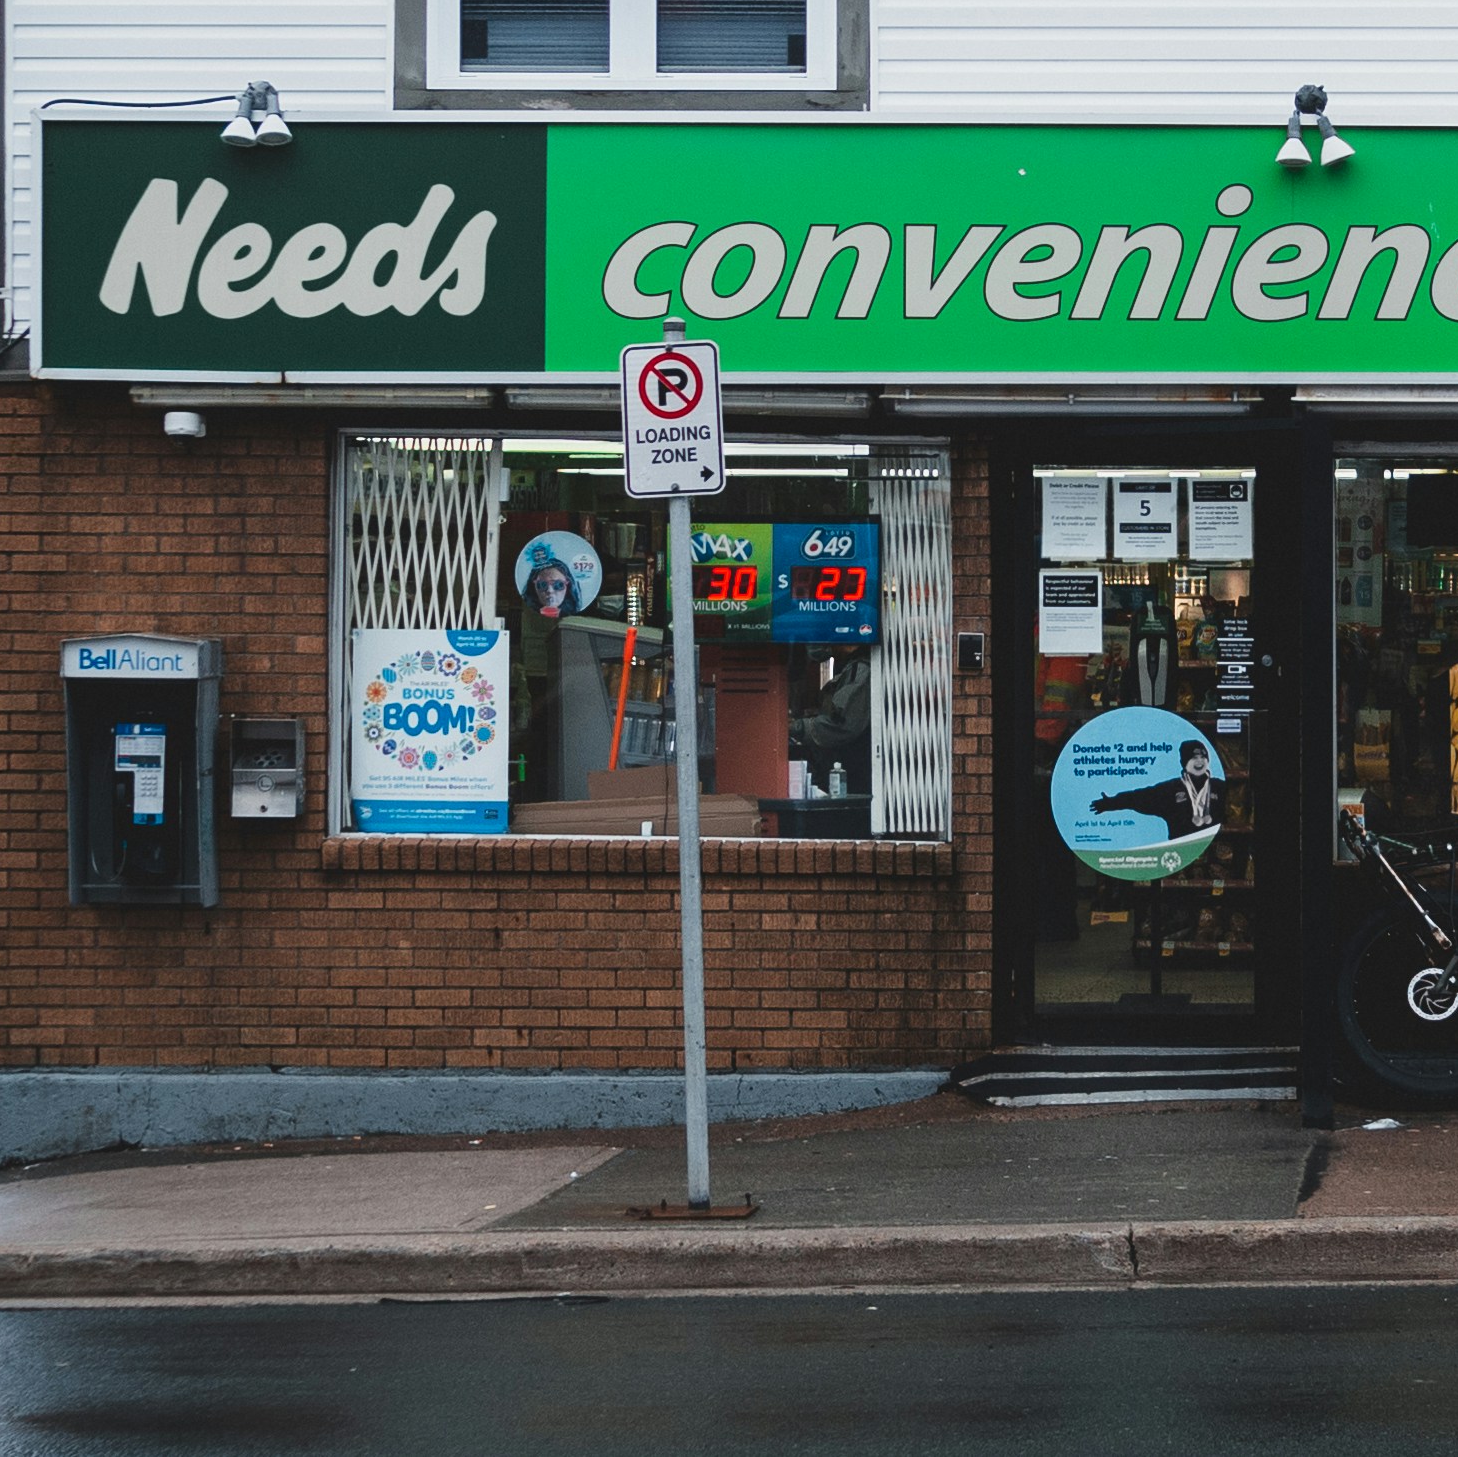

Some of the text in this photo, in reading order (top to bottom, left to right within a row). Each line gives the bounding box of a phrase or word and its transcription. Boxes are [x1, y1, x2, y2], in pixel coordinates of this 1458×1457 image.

[99, 177, 497, 319] Needs
[636, 425, 711, 444] LOADING
[651, 447, 698, 464] ZONE
[1140, 500, 1151, 516] 5
[690, 532, 749, 562] MAX
[708, 567, 758, 601] 30
[778, 574, 788, 589] $
[692, 602, 748, 612] MILLIONS
[799, 602, 856, 612] MILLIONS
[402, 688, 455, 700] BONUS
[383, 700, 475, 737] BOOM!
[1072, 744, 1111, 753] Donate
[1126, 742, 1147, 752] and
[1149, 742, 1172, 753] help
[1073, 754, 1156, 765] athletes hungry
[1074, 765, 1148, 778] to participate.
